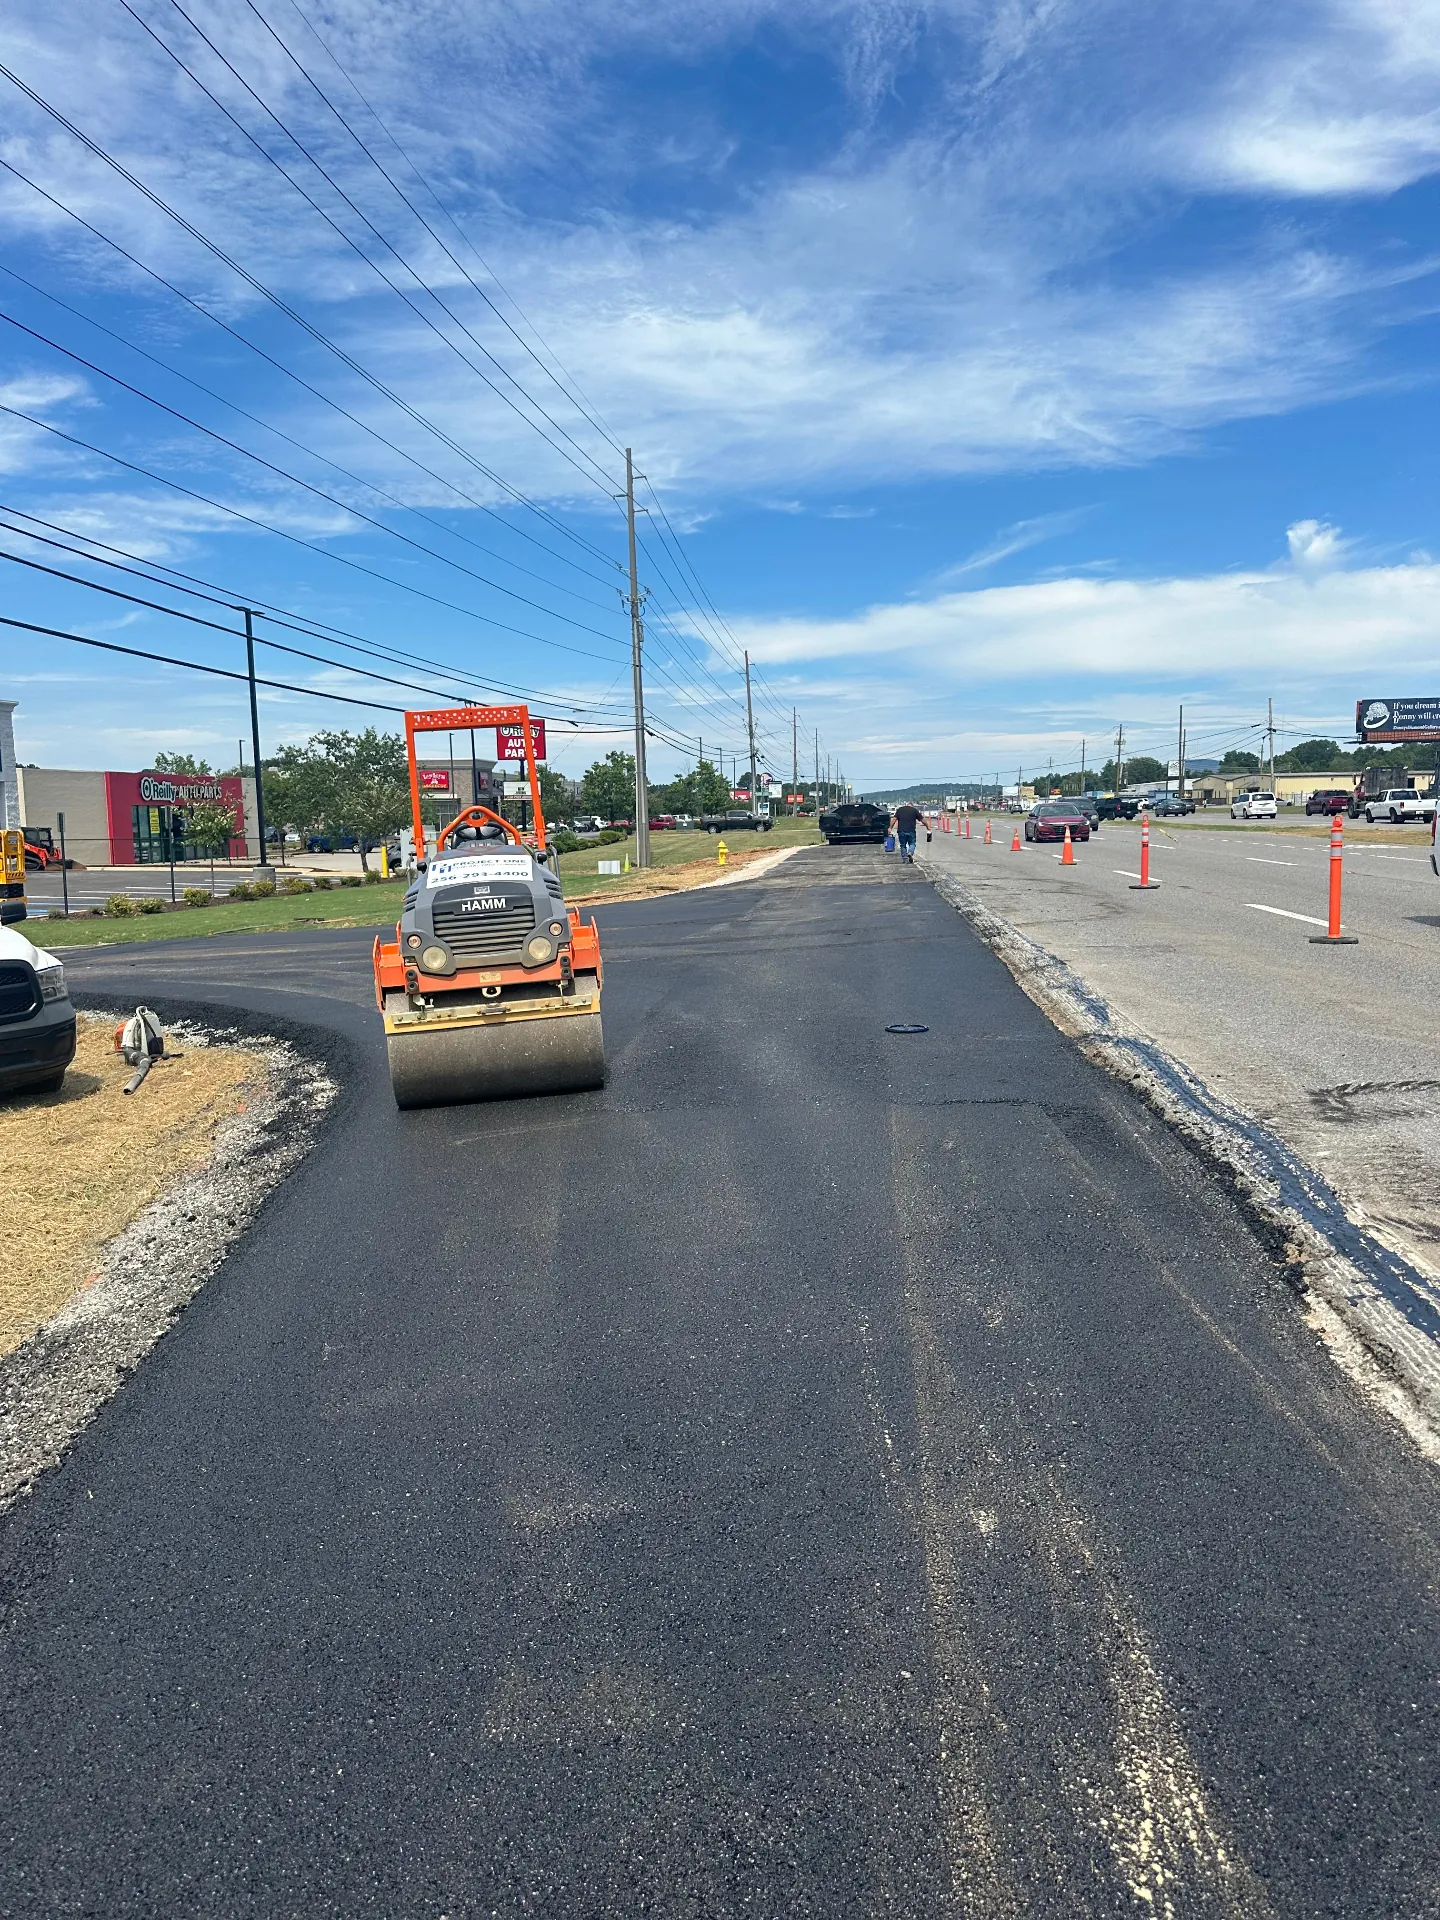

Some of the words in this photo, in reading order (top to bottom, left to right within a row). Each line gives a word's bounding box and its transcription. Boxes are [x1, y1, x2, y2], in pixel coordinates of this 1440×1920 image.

[1400, 704, 1413, 712] you
[1415, 702, 1436, 710] dream
[505, 748, 538, 758] PARS
[461, 898, 506, 912] HAMM
